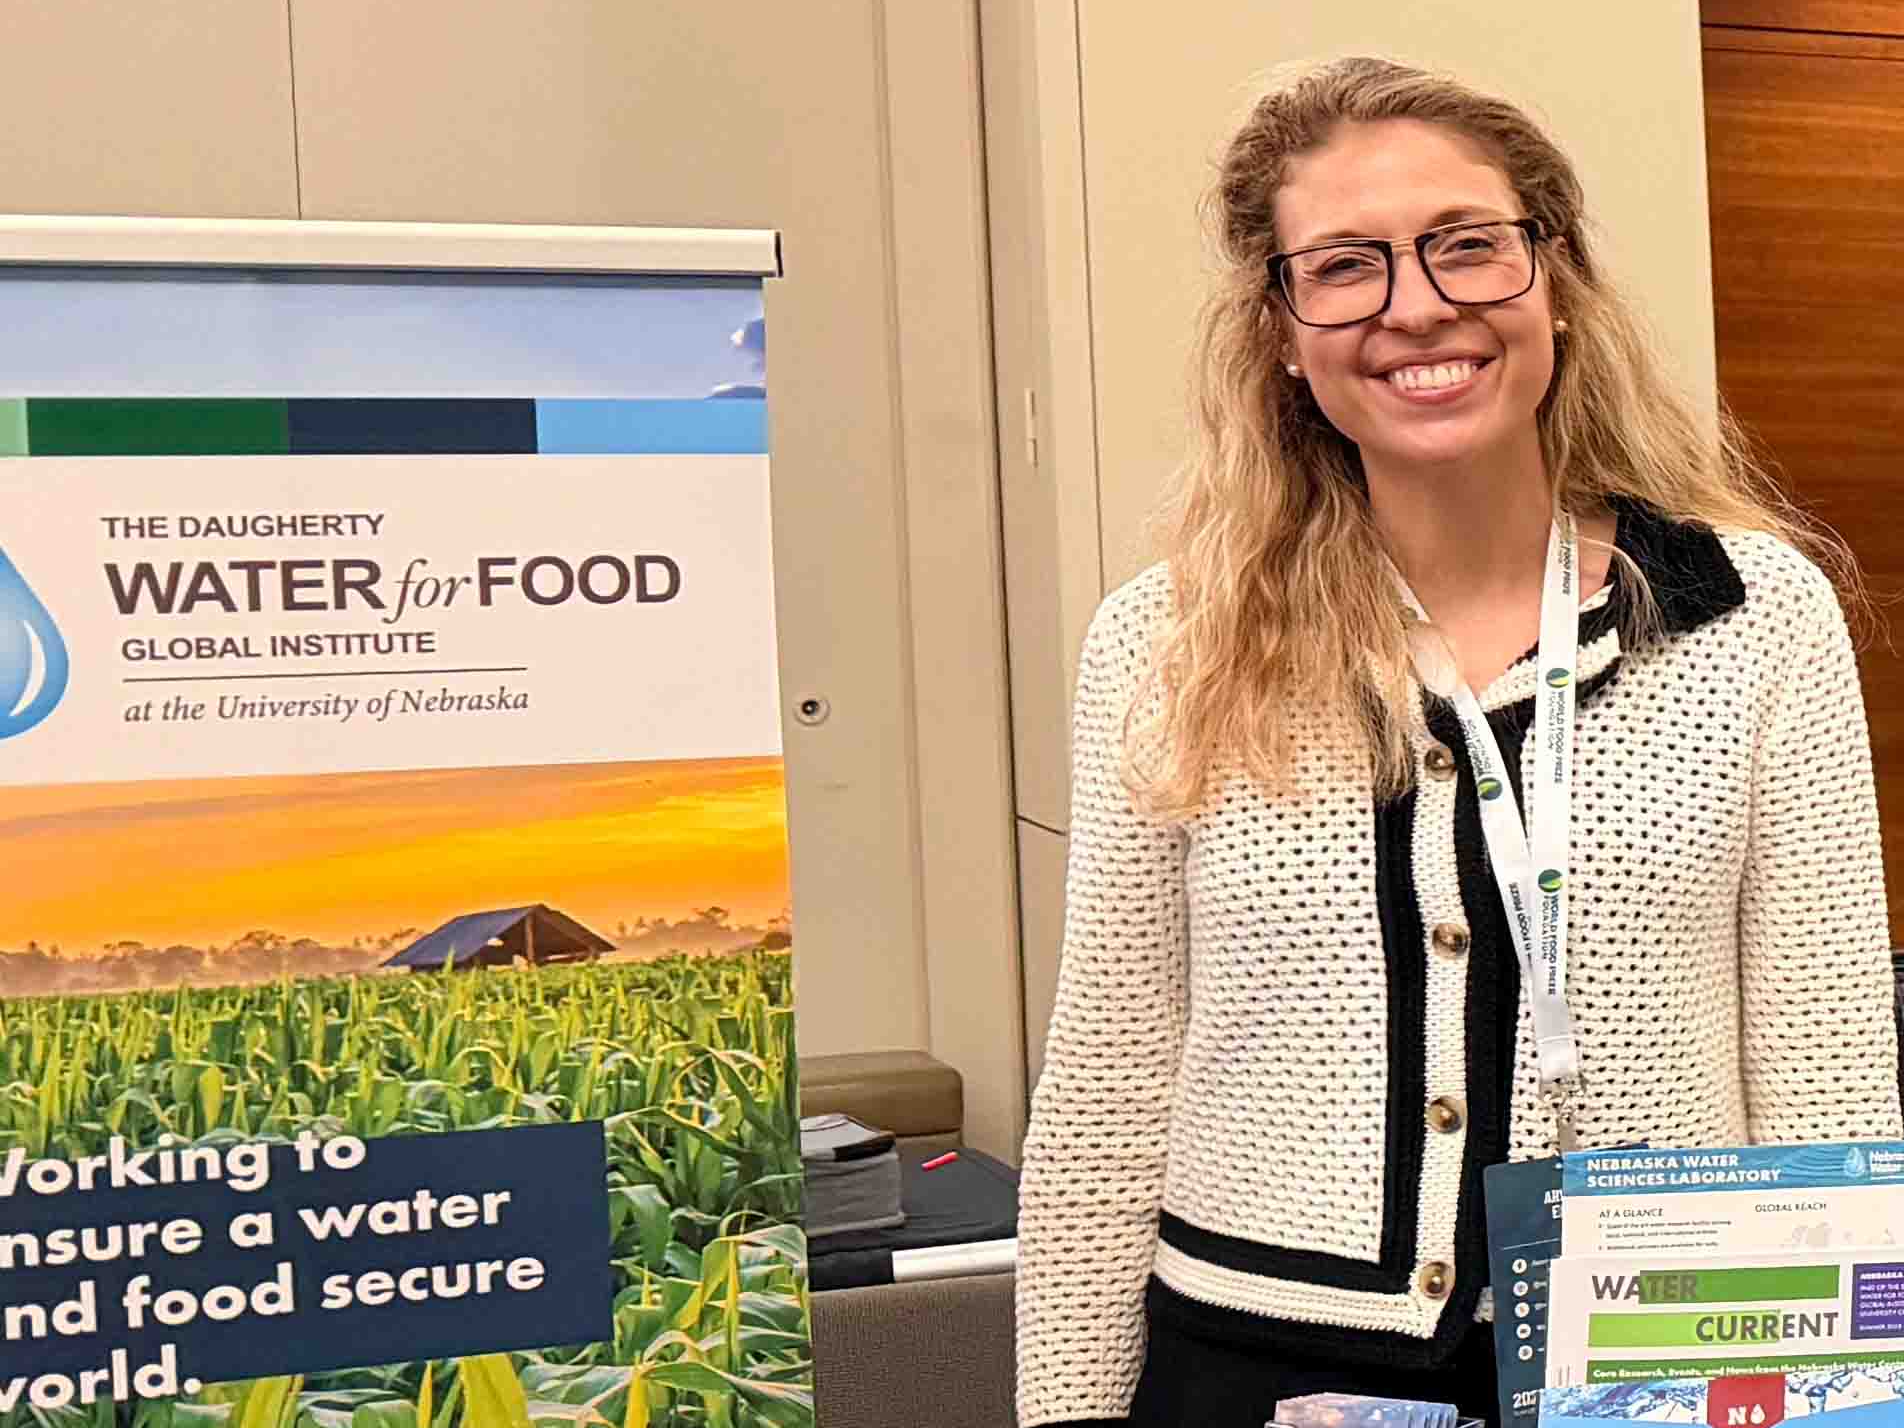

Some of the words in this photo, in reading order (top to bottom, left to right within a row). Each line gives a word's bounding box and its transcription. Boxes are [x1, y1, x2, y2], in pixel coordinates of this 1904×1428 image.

[102, 516, 169, 540] THE
[178, 513, 385, 538] DAUGHERTY
[104, 560, 387, 614] WATER
[383, 557, 470, 624] for
[478, 555, 681, 606] FOOD
[122, 635, 261, 661] GLOBAL
[271, 632, 436, 658] INSTITUTE
[124, 699, 153, 723] at
[162, 696, 205, 721] the
[217, 690, 359, 723] University
[366, 687, 401, 723] of
[401, 687, 529, 712] Nebraska
[295, 1131, 365, 1172] to
[1587, 1157, 1678, 1171] NEBRASKA
[1683, 1155, 1738, 1168] WATER
[1587, 1173, 1665, 1188] SCIENCES
[1670, 1169, 1781, 1185] LABORATORY
[0, 1215, 202, 1268] nsure
[230, 1212, 273, 1247] a
[299, 1189, 510, 1240] water
[4, 1281, 97, 1340] nd
[123, 1262, 294, 1328] food
[321, 1257, 545, 1309] secure
[1591, 1275, 1698, 1301] WATER
[1696, 1312, 1839, 1342] CURRENT
[1728, 1407, 1747, 1425] N
